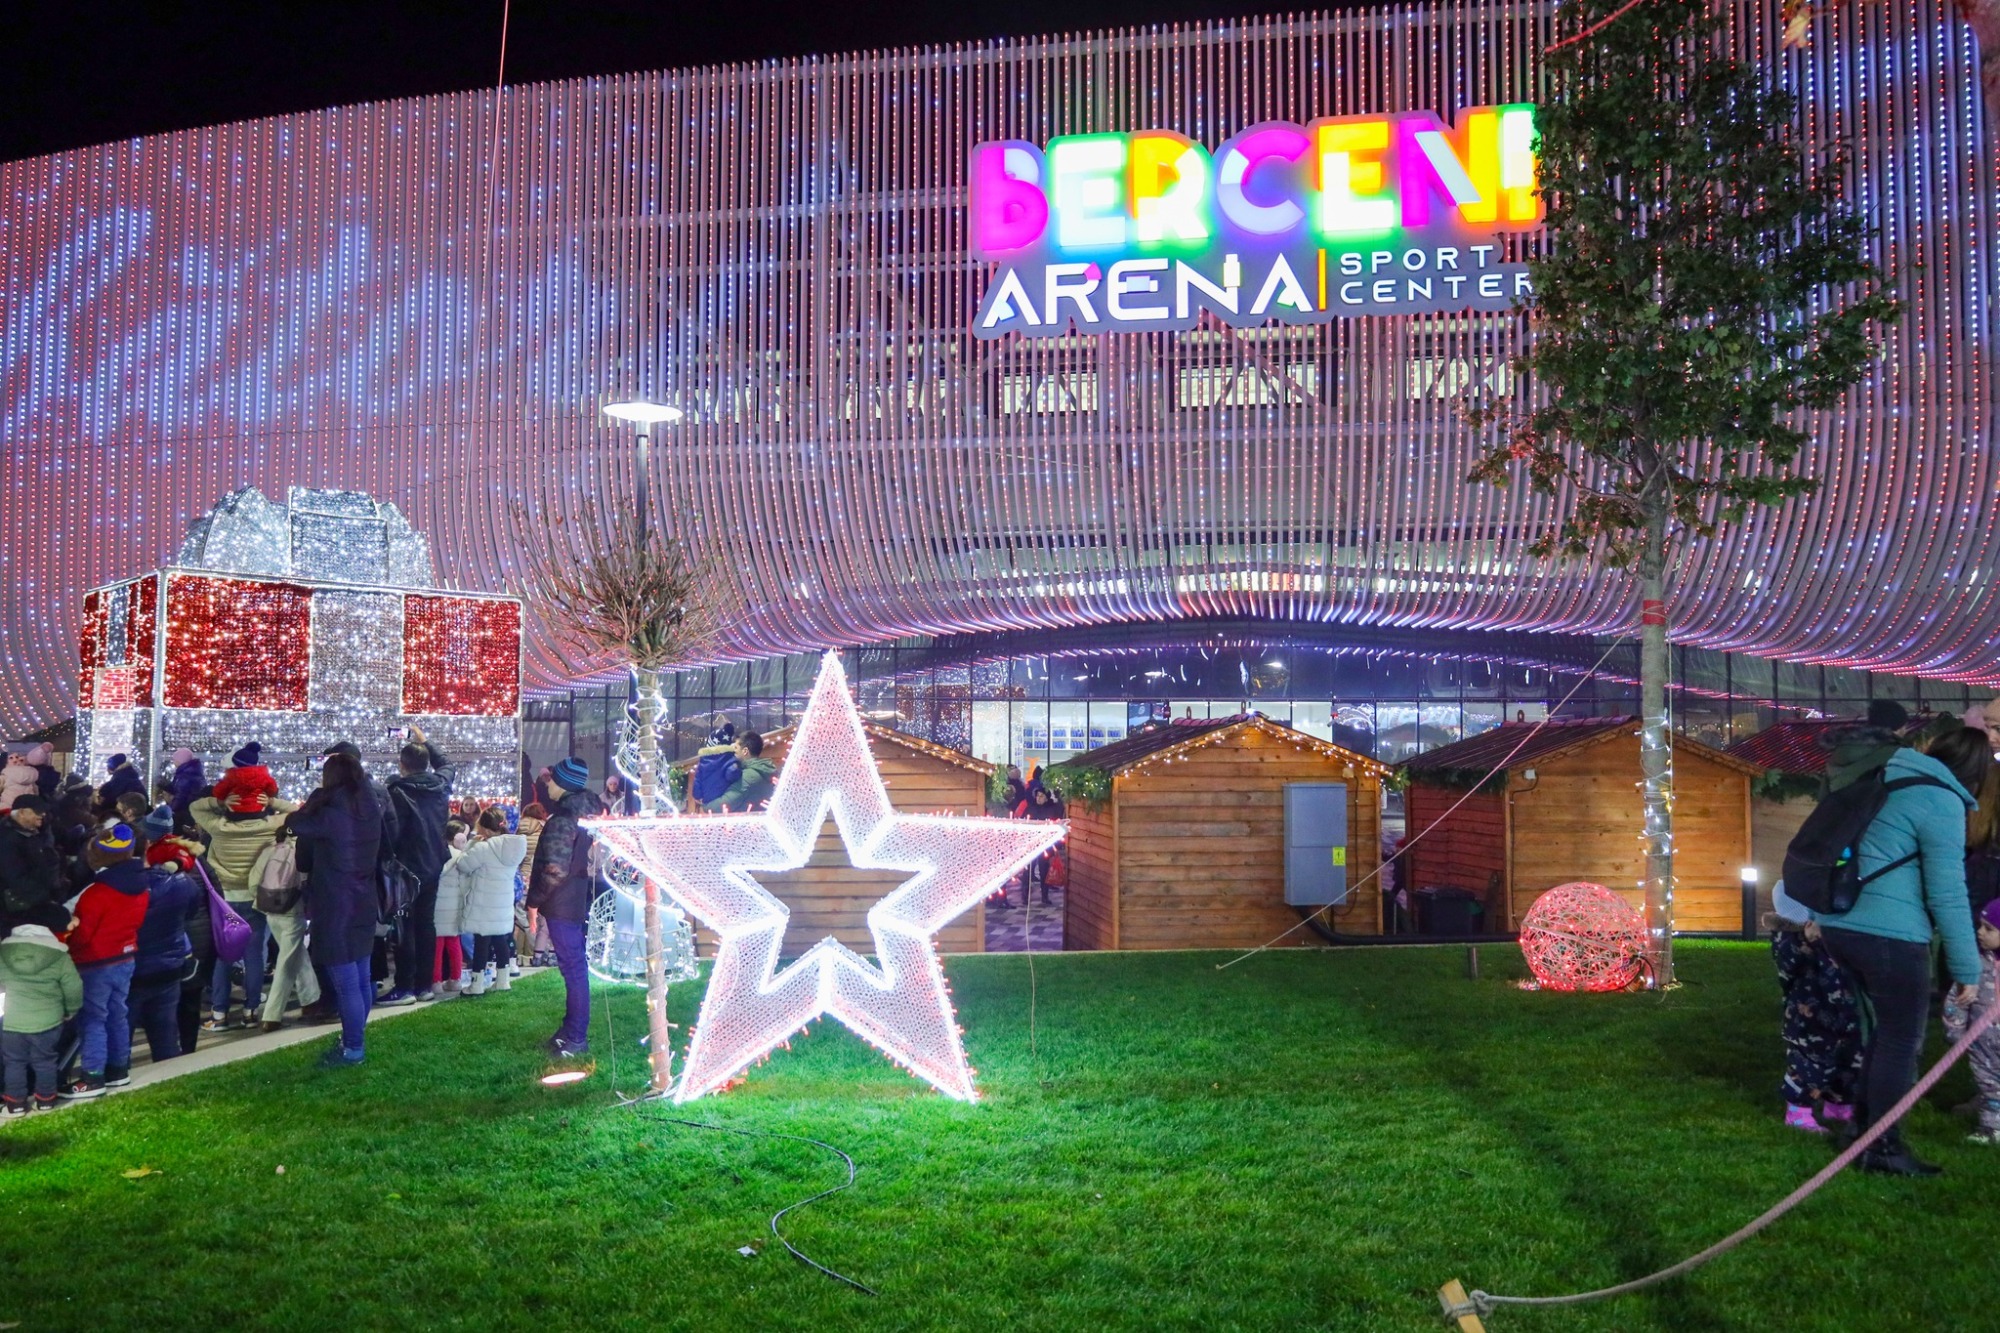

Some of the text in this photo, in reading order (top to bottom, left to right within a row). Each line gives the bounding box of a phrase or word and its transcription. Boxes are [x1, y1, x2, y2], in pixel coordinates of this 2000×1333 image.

[979, 110, 1536, 251] BERCENI
[1340, 245, 1493, 275] SPORT
[982, 252, 1313, 328] ARENA
[1340, 272, 1533, 304] CENTER
